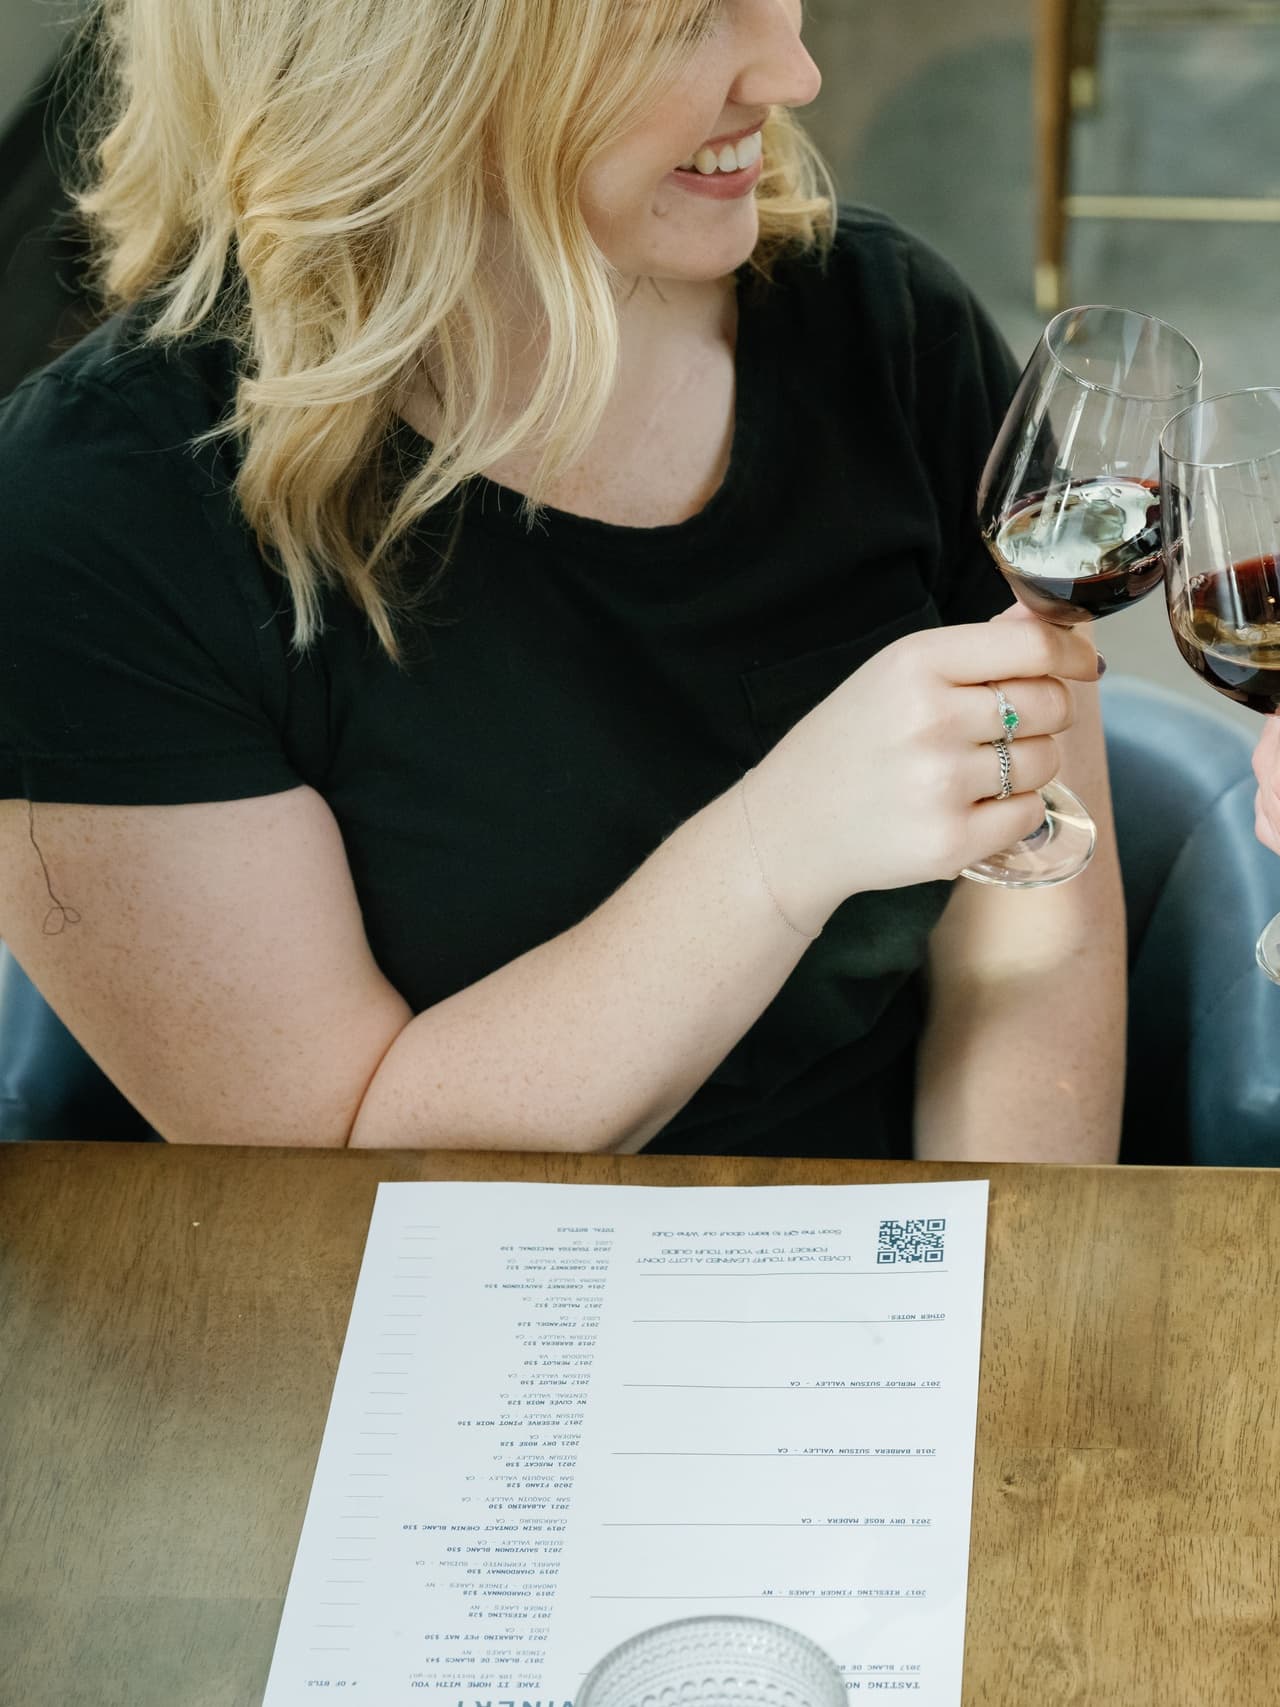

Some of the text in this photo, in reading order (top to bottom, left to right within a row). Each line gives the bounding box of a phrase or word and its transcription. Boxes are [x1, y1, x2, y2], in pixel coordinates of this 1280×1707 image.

[752, 1256, 784, 1264] TOUR?
[436, 1681, 461, 1689] WITH
[467, 1681, 491, 1689] HOME
[497, 1681, 510, 1689] IT
[516, 1681, 540, 1689] TAKE
[868, 1681, 920, 1690] TASTING
